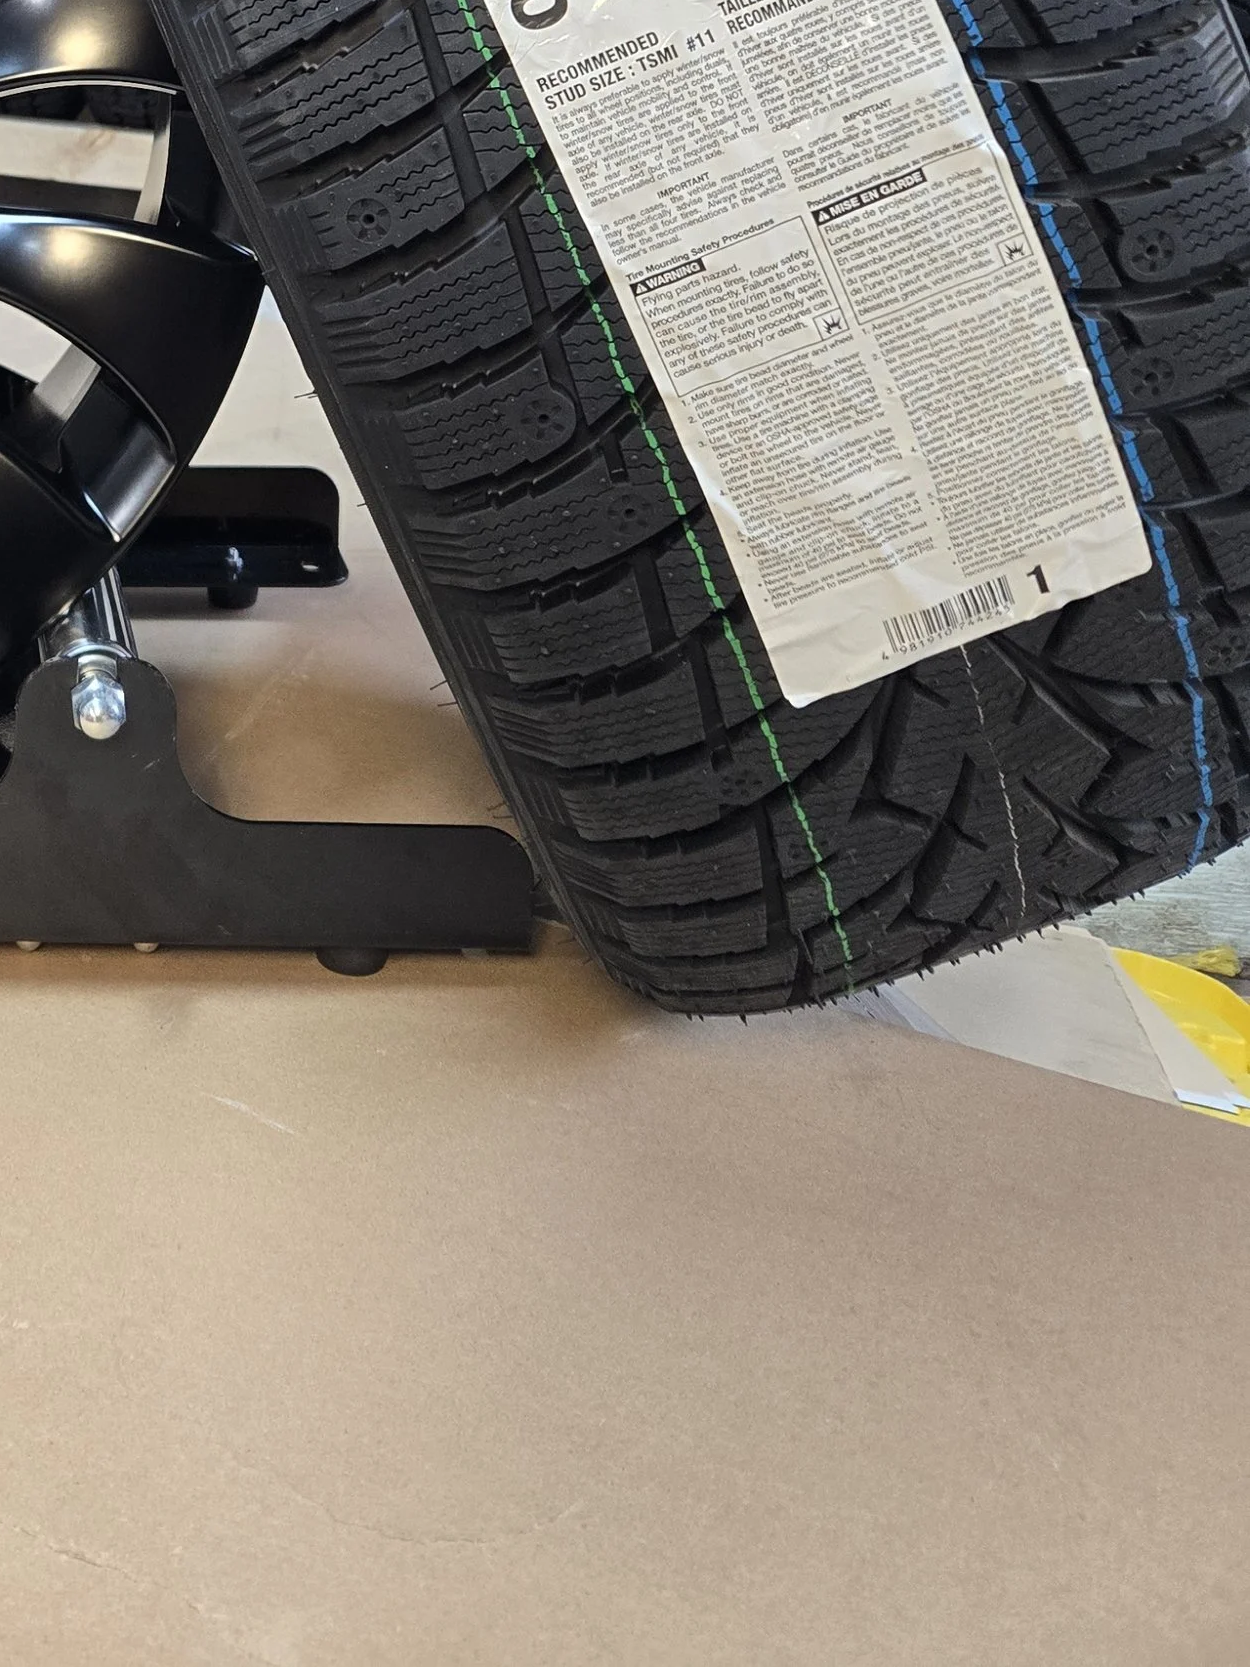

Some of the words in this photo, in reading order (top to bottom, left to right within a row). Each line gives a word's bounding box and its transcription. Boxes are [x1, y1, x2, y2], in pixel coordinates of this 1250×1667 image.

[535, 31, 659, 93] RECOMMENDED
[544, 83, 587, 111] STUD
[588, 65, 627, 92] SIZE
[635, 44, 679, 72] TSMI
[686, 28, 715, 53] #11
[841, 97, 892, 124] IMPORTANT
[656, 171, 710, 200] IMPORTANT
[828, 196, 861, 217] MISE
[859, 188, 880, 204] EN
[879, 170, 923, 196] GARDE
[624, 270, 645, 282] Tire
[644, 252, 691, 274] Mounting
[690, 240, 721, 257] Safety
[721, 218, 776, 245] Procedures
[645, 261, 701, 289] WARNING
[640, 290, 675, 308] Flying
[674, 278, 702, 298] parts
[701, 263, 742, 284] hazard.
[644, 302, 677, 319] When
[676, 283, 724, 308] mounting
[722, 275, 750, 289] tires,
[748, 261, 779, 280] follow
[779, 248, 809, 267] safety
[650, 302, 705, 331] procedures
[704, 288, 742, 309] exactly.
[741, 275, 776, 294] Failure
[774, 270, 787, 281] to
[786, 264, 802, 275] do
[800, 258, 815, 271] so
[654, 326, 676, 341] can
[677, 313, 708, 332] cause
[708, 305, 728, 318] the
[727, 290, 768, 311] tire/rim
[768, 269, 821, 295] assembly,
[658, 337, 677, 349] the
[676, 331, 698, 343] tire,
[697, 324, 708, 335] or
[708, 317, 726, 330] the
[726, 311, 744, 323] tire
[743, 298, 771, 316] bead
[770, 295, 783, 305] to
[782, 290, 796, 301] fly
[796, 277, 824, 295] apart
[663, 332, 721, 359] explosively.
[719, 318, 755, 337] Failure
[755, 313, 768, 323] to
[768, 297, 805, 318] comply
[805, 288, 829, 303] with
[668, 356, 686, 369] any
[687, 350, 699, 361] of
[698, 341, 726, 358] these
[726, 328, 756, 346] safety
[756, 306, 813, 336] procedures
[812, 299, 833, 312] can
[672, 361, 703, 379] cause
[702, 348, 738, 368] serious
[736, 334, 764, 353] injury
[764, 332, 776, 342] or
[776, 320, 809, 338] death.
[1026, 564, 1051, 595] 1
